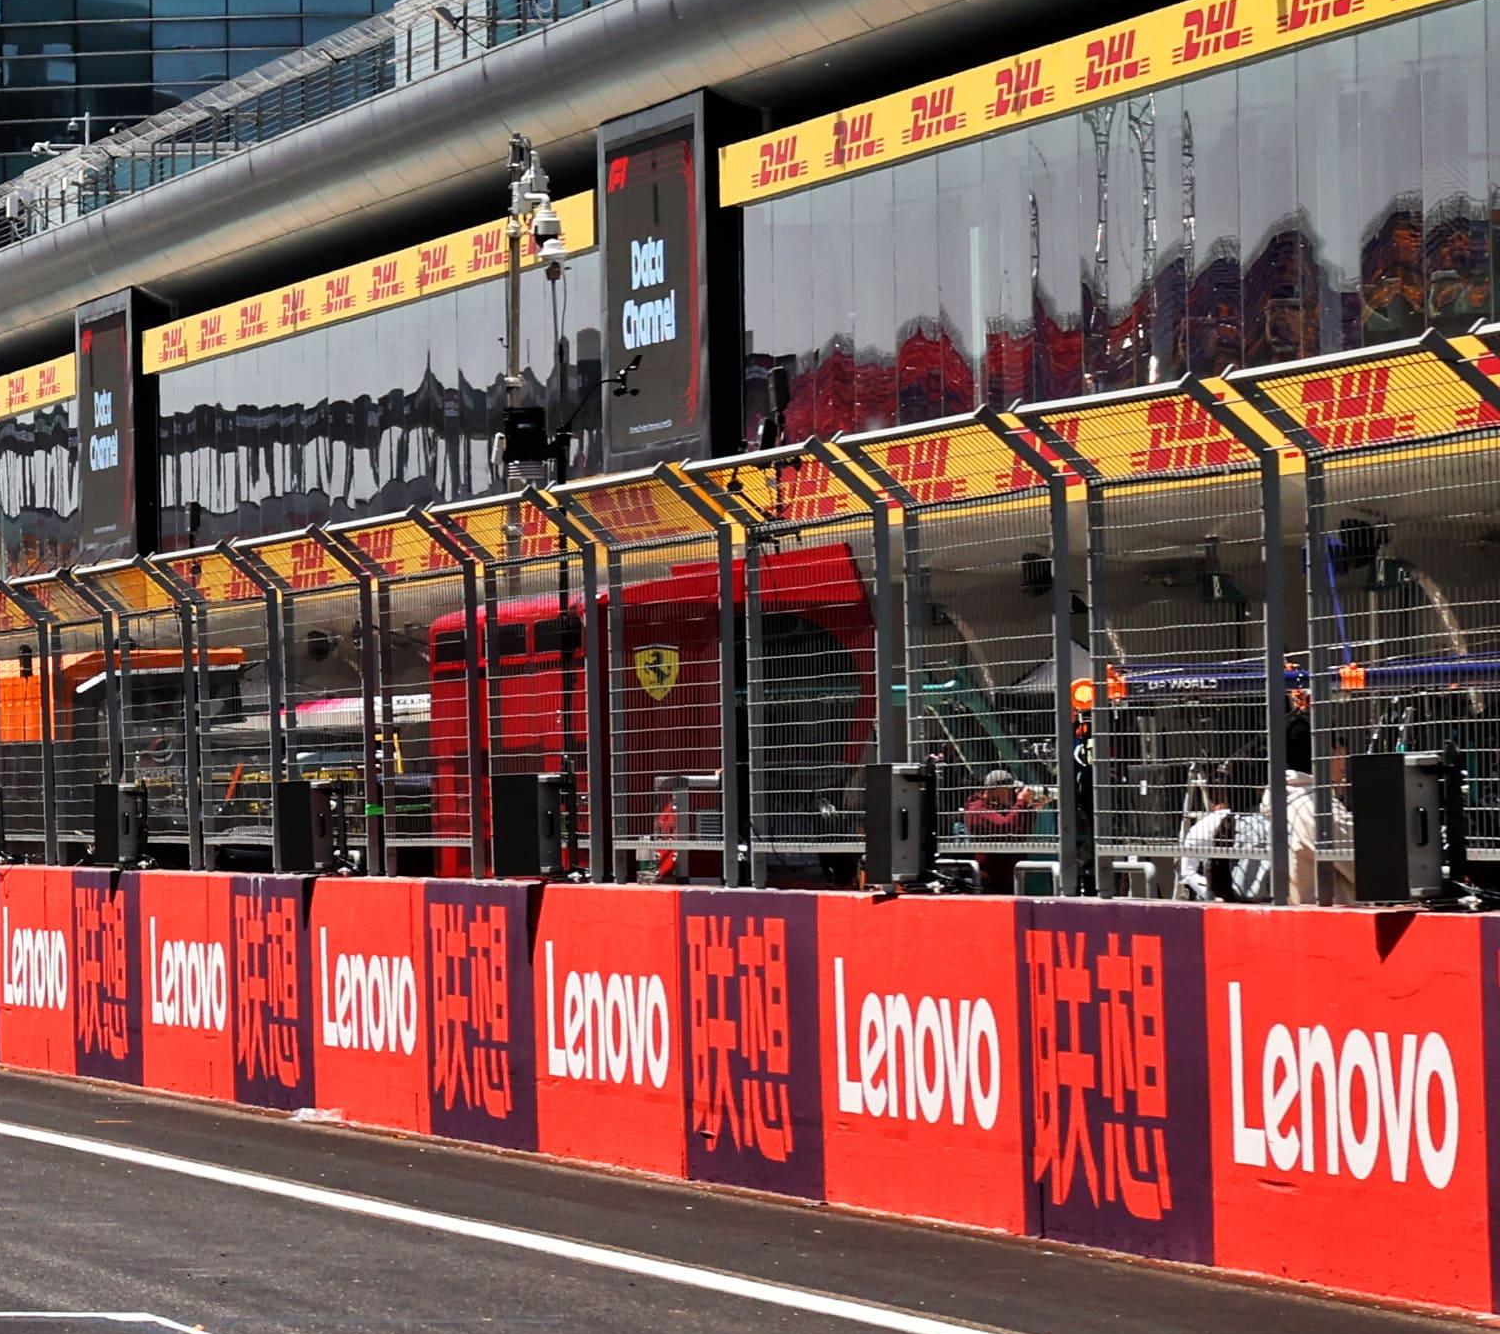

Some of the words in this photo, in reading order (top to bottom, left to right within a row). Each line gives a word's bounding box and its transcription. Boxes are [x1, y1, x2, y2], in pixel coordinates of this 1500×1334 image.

[911, 86, 958, 142] DHL
[994, 59, 1047, 117] DHL
[1084, 30, 1141, 91] DHL
[759, 136, 801, 186] DHL
[833, 113, 877, 165] DHL
[622, 289, 677, 350] Channel
[631, 237, 665, 290] Data
[3, 906, 67, 1011] Lenovo
[76, 886, 128, 1061] 联想
[149, 916, 227, 1031] Lenovo
[235, 894, 300, 1088] 联想
[319, 926, 418, 1056] Lenovo
[429, 902, 511, 1118] 联想
[545, 940, 670, 1089] Lenovo
[686, 915, 793, 1162] 联想
[834, 957, 1000, 1130] Lenovo
[1025, 929, 1172, 1220] 联想
[1228, 981, 1459, 1189] Lenovo
